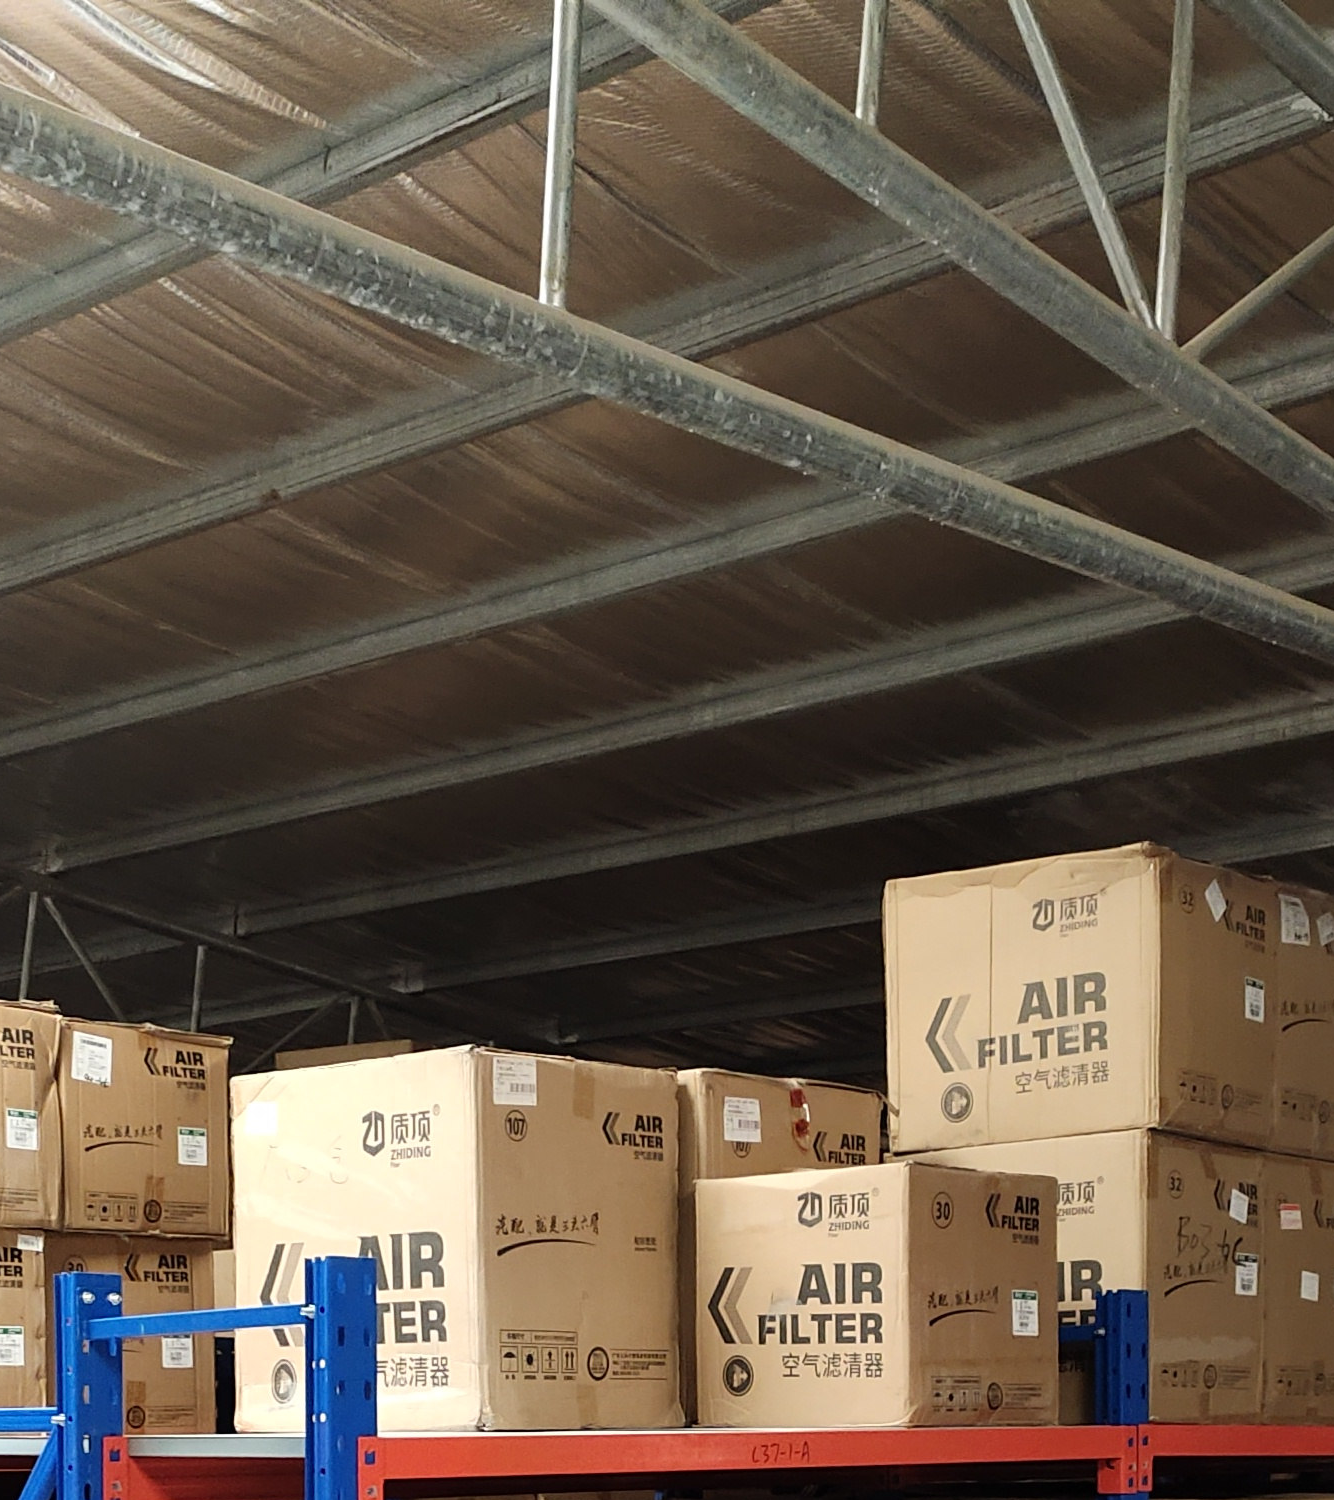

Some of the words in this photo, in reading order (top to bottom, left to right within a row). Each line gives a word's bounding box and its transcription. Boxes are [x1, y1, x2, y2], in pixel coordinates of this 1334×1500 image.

[1059, 893, 1098, 922] 质顶
[1245, 905, 1266, 926] AIR
[1059, 918, 1098, 934] ZHIDING
[1235, 922, 1266, 940] FILTER
[1017, 971, 1107, 1025] AIR
[2, 1028, 34, 1046] AIR
[976, 1021, 1109, 1069] FILTER
[175, 1050, 204, 1066] AIR
[162, 1066, 206, 1081] FILTER
[1015, 1060, 1109, 1094] 空气滤清器
[390, 1109, 431, 1145] 质顶
[507, 1118, 525, 1136] 107
[635, 1115, 663, 1133] AIR
[621, 1133, 663, 1149] FILTER
[840, 1133, 866, 1151] AIR
[390, 1145, 431, 1160] ZHIDING
[828, 1152, 866, 1165] FILTER
[1169, 1177, 1183, 1191] 32
[828, 1192, 870, 1220] 质顶
[935, 1201, 950, 1221] 30
[1014, 1195, 1040, 1215] AIR
[828, 1220, 870, 1232] ZHIDING
[1001, 1214, 1040, 1232] FILTER
[158, 1254, 187, 1269] AIR
[357, 1231, 445, 1291] AIR
[144, 1270, 189, 1283] FILTER
[795, 1262, 883, 1305] AIR
[757, 1313, 884, 1345] FILTER
[376, 1355, 449, 1388] 气滤清器
[782, 1352, 884, 1378] 空气滤清器
